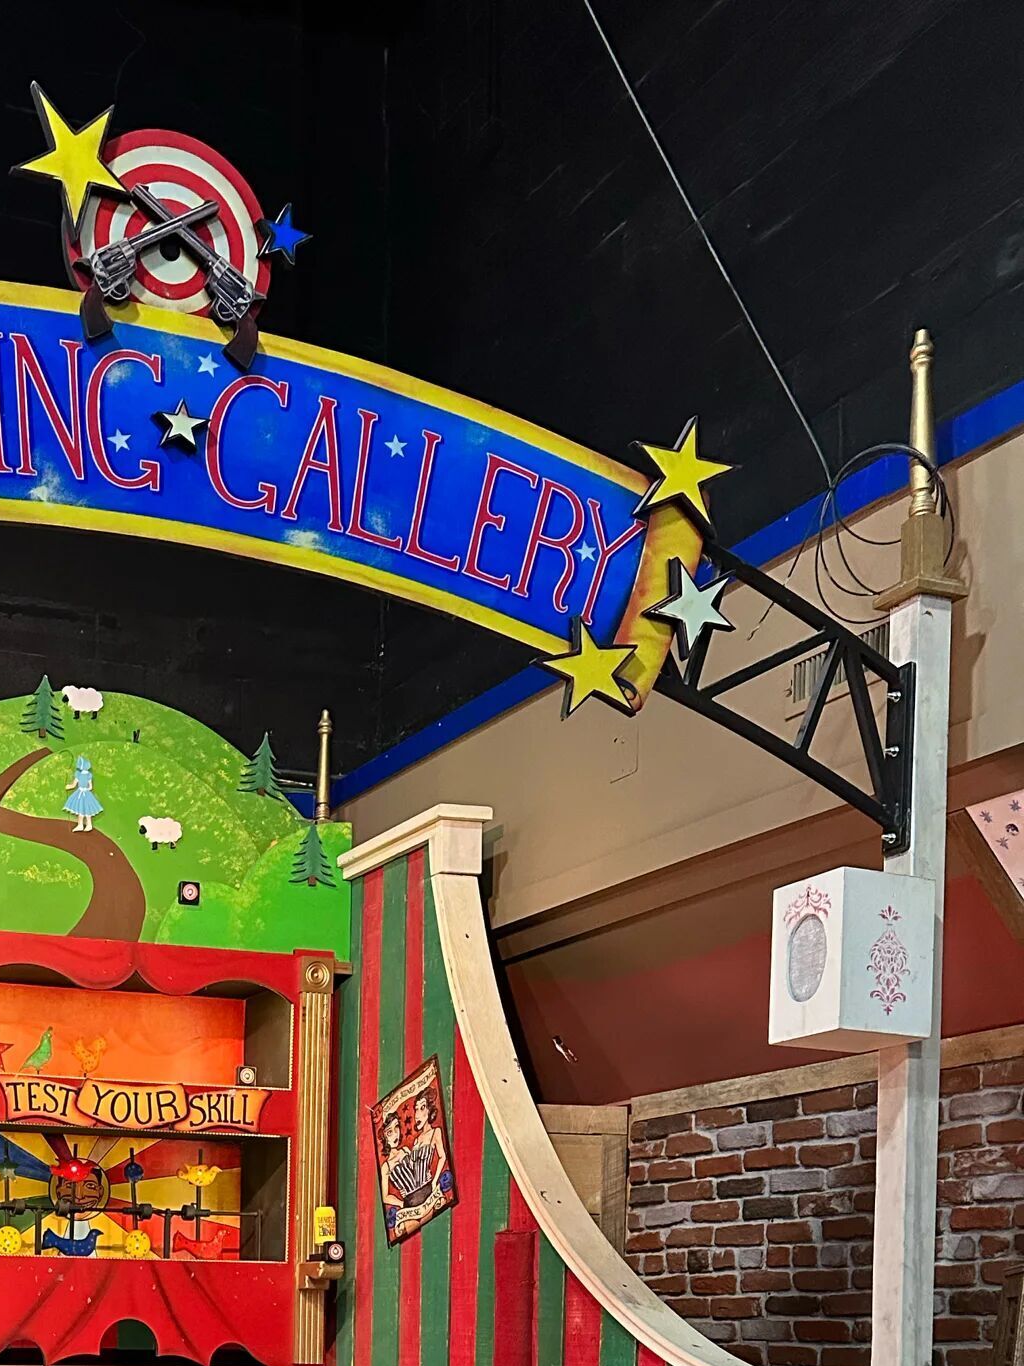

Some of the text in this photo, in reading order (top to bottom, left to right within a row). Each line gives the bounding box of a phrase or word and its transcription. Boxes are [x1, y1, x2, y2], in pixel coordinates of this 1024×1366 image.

[204, 374, 647, 626] GALLERY
[6, 1081, 255, 1128] TEST YOUR SKILL
